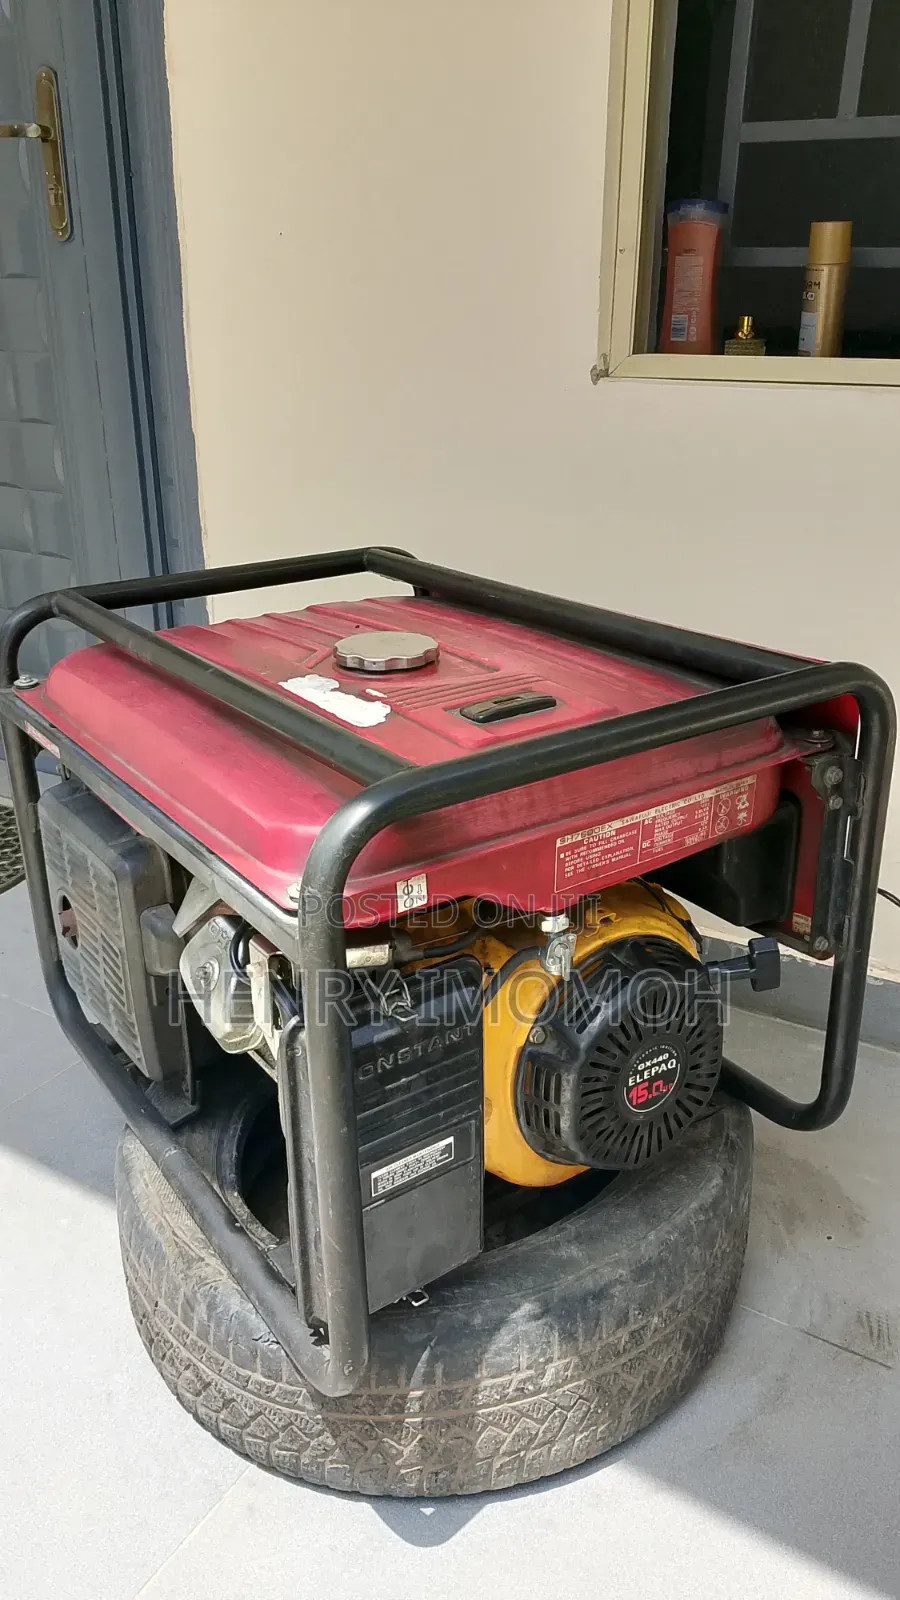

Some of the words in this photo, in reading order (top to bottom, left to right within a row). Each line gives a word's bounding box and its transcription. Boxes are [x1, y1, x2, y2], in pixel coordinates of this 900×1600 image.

[644, 817, 653, 825] AC
[583, 829, 617, 845] CAUTION
[642, 841, 651, 849] DC
[628, 1058, 677, 1087] ELEPAQ
